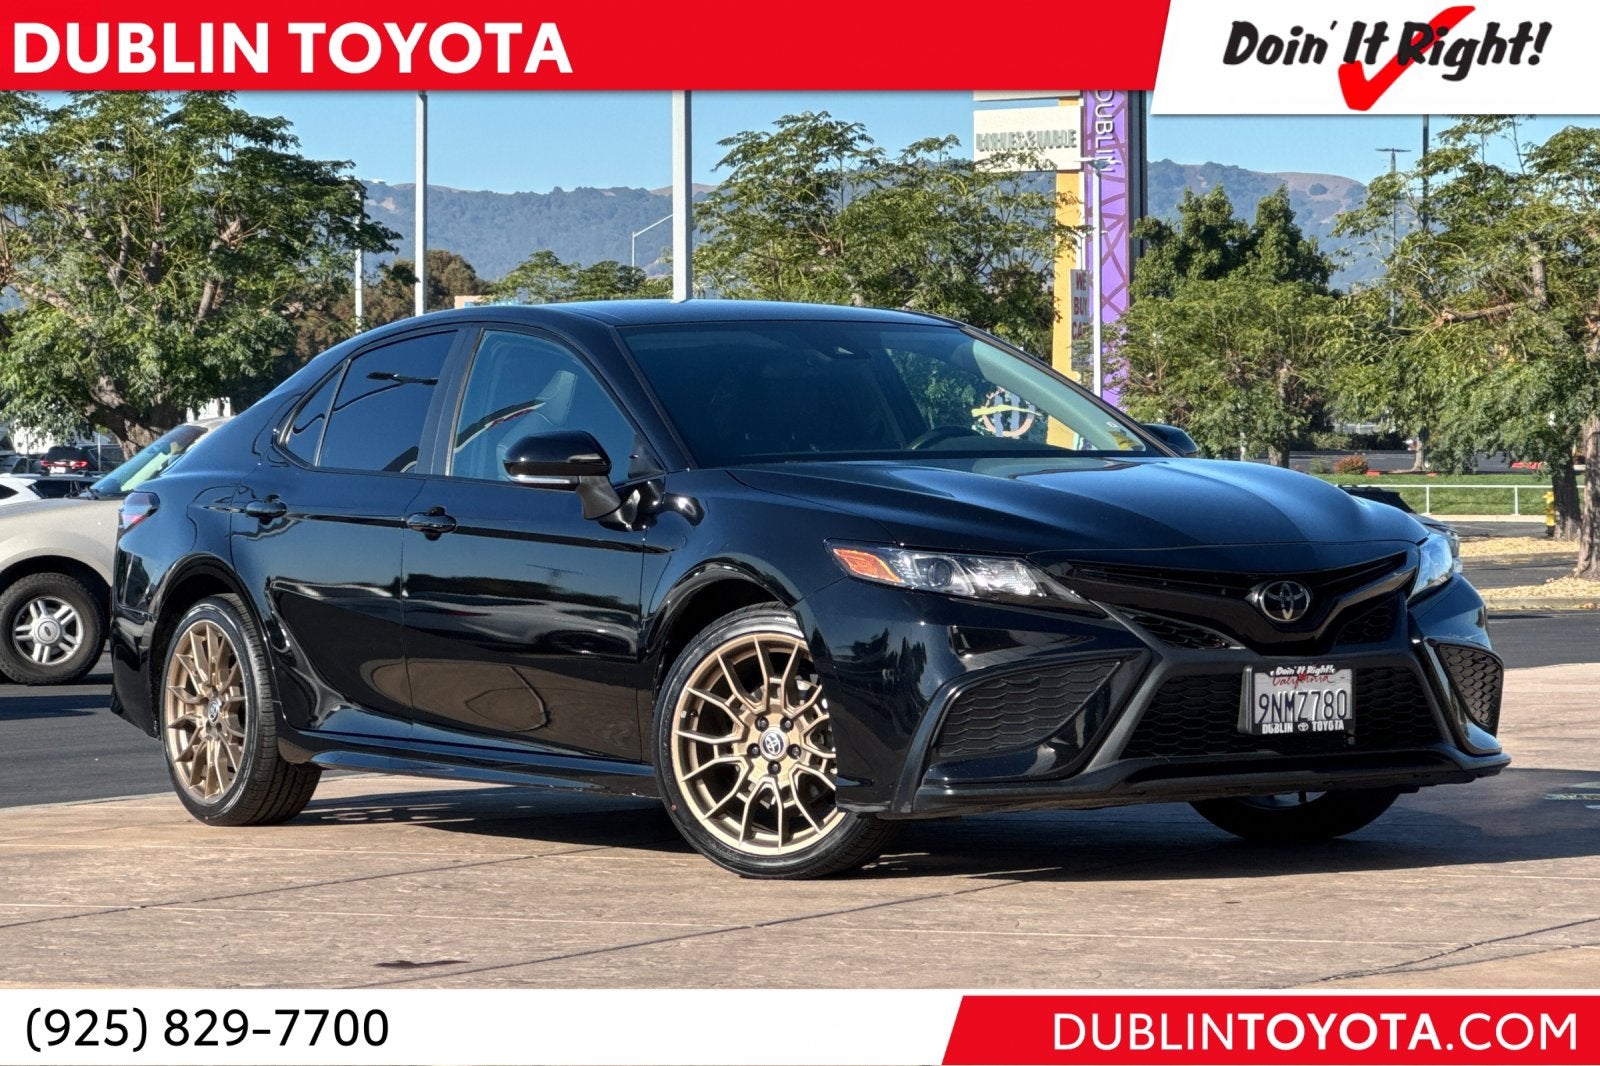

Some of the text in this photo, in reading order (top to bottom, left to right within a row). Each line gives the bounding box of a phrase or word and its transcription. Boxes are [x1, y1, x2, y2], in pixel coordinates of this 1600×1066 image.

[1075, 271, 1087, 291] WE
[1073, 297, 1089, 316] BUY
[1258, 689, 1348, 723] 9NMZ780
[1262, 719, 1344, 734] DUBLIN TOYOTA
